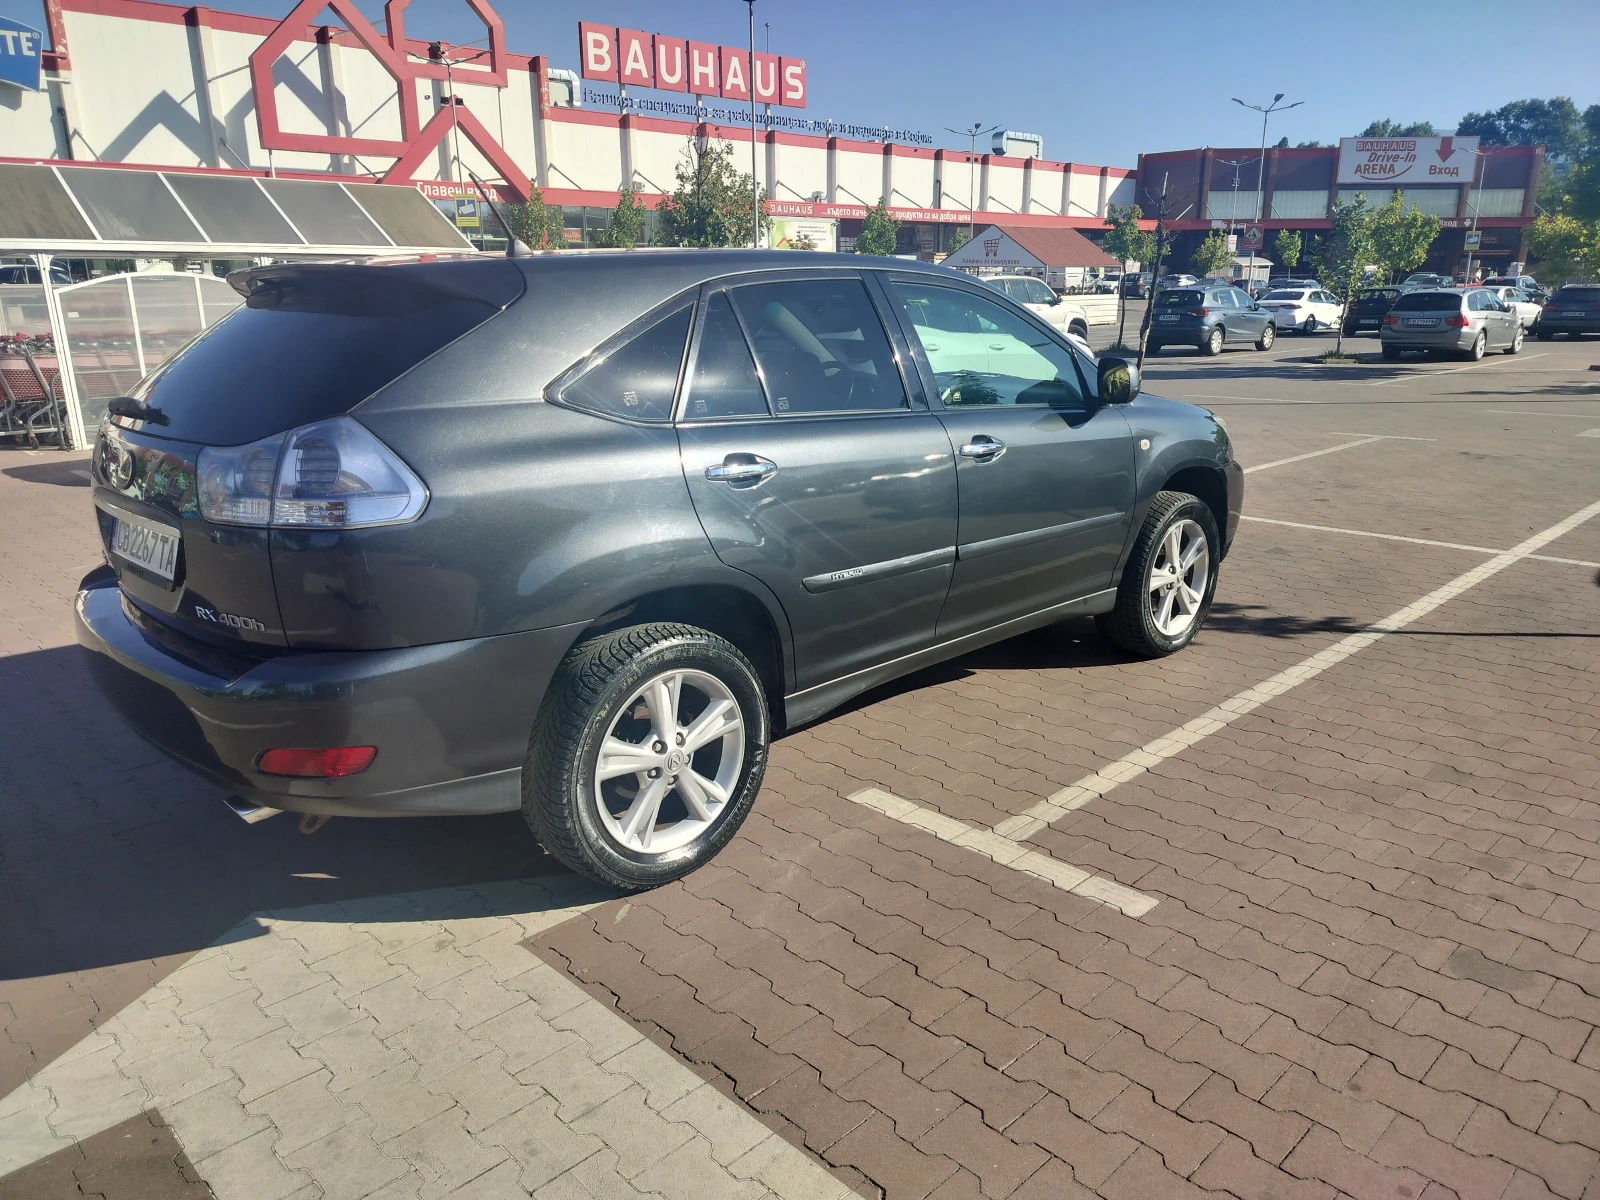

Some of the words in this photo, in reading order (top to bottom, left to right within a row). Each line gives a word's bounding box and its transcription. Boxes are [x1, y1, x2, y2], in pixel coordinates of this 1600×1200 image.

[0, 29, 36, 57] TE
[586, 31, 804, 100] BAUHAUS
[1356, 141, 1416, 151] BAUHAUS
[1367, 152, 1417, 163] Drive-In
[1354, 163, 1396, 175] ARENA
[1428, 165, 1459, 177] Вход
[770, 203, 813, 215] BAUHAUS
[895, 211, 923, 221] продукти
[931, 212, 939, 220] на
[940, 212, 957, 222] добра
[957, 213, 971, 221] цена
